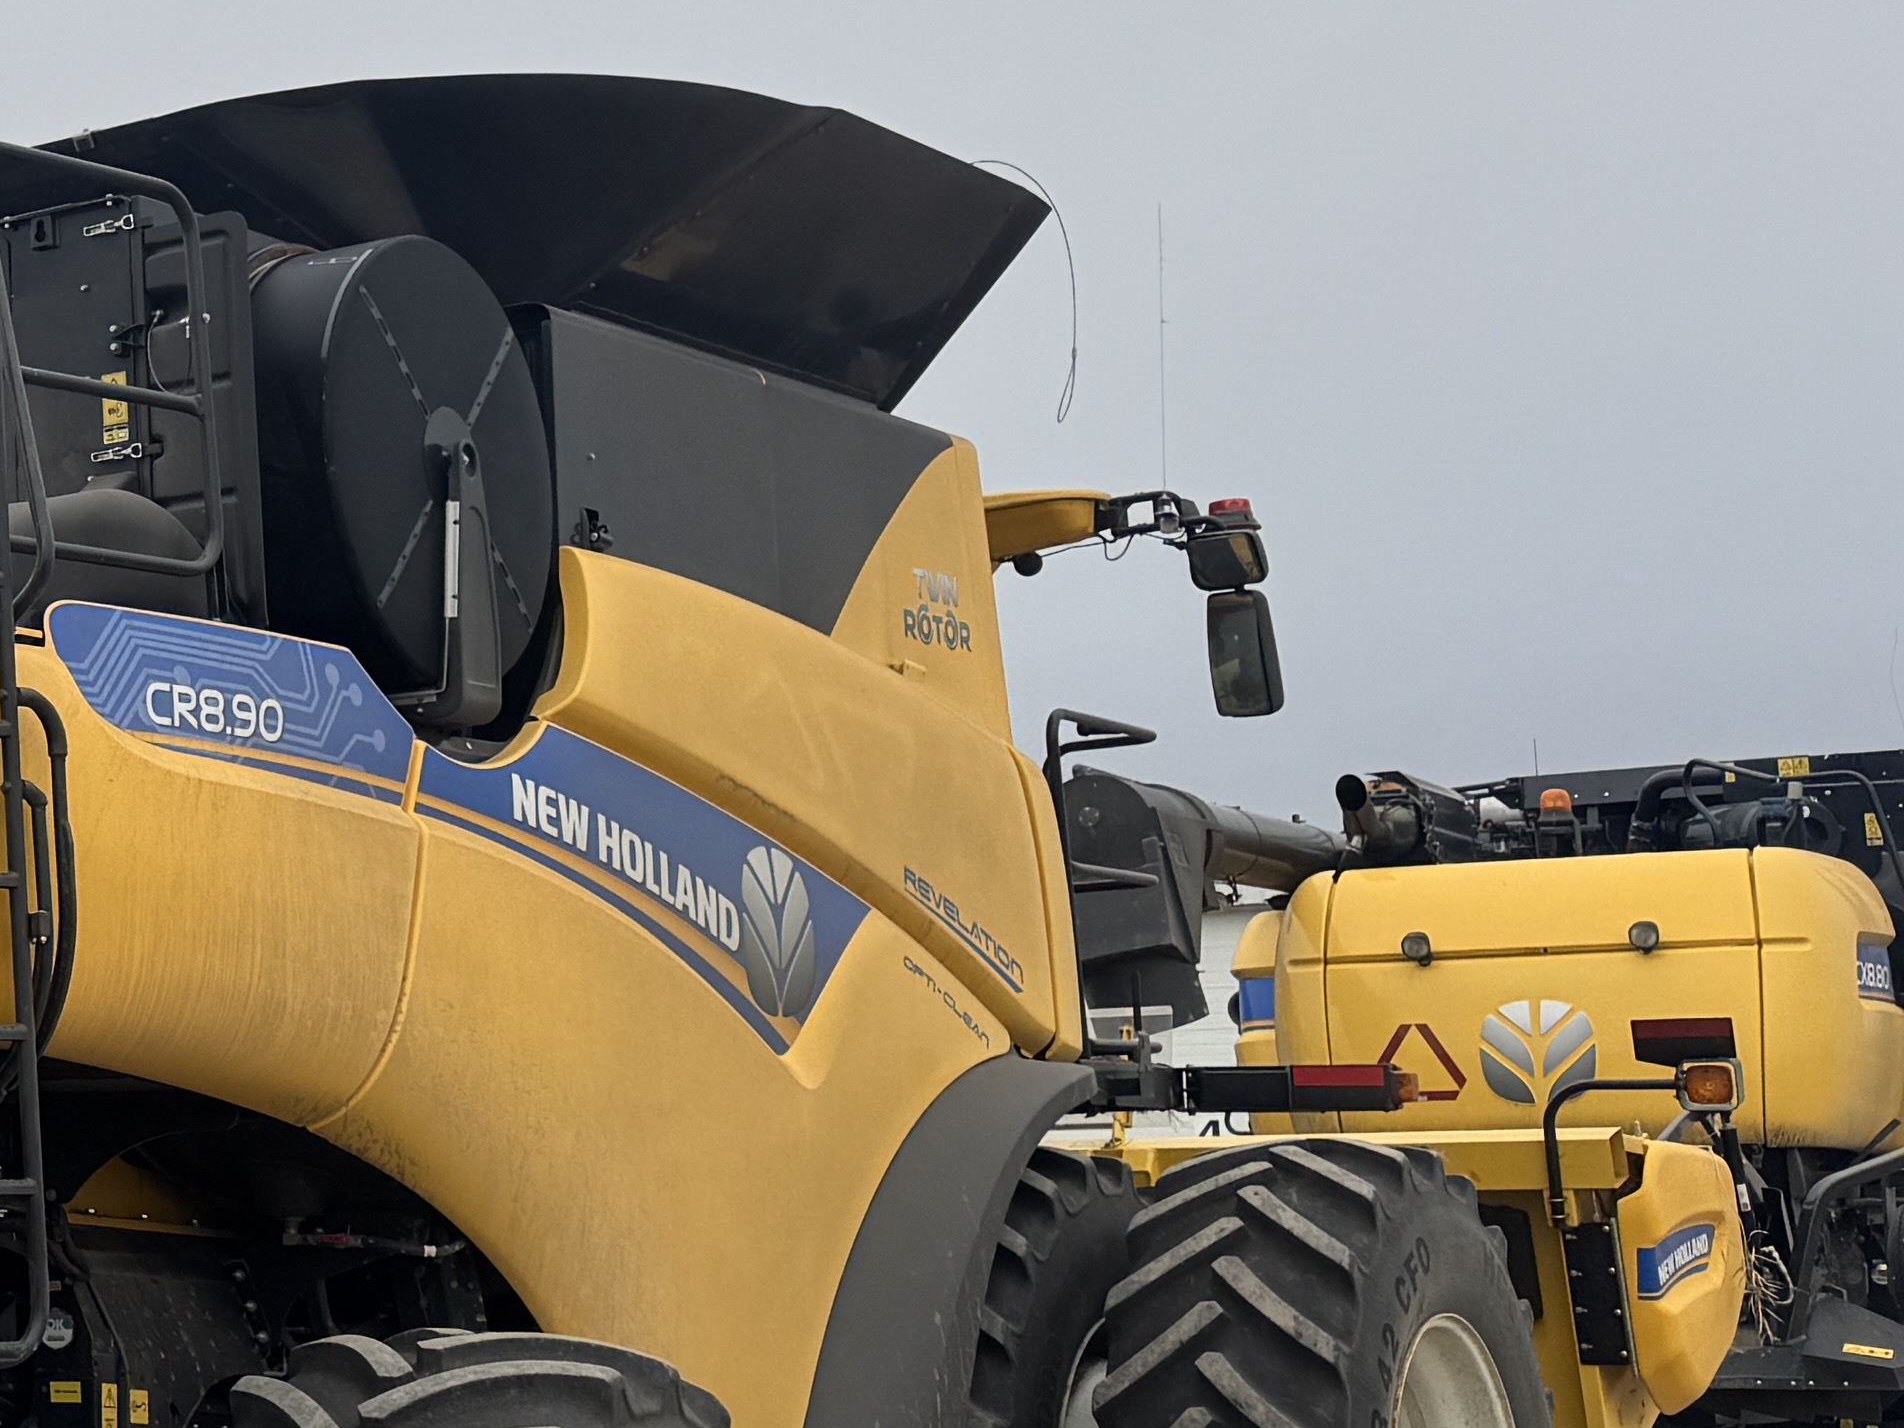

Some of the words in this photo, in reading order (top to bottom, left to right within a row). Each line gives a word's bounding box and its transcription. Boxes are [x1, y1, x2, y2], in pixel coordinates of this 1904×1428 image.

[912, 568, 959, 608] TWIN
[903, 604, 972, 652] ROTOR
[145, 682, 284, 743] CR8.90
[511, 773, 590, 852] NEW
[597, 813, 740, 952] HOLLAND
[903, 865, 1024, 985] REVELATION
[1657, 1252, 1676, 1286] NEW
[1674, 1234, 1709, 1270] HOLLAND
[1377, 1322, 1400, 1393] 42
